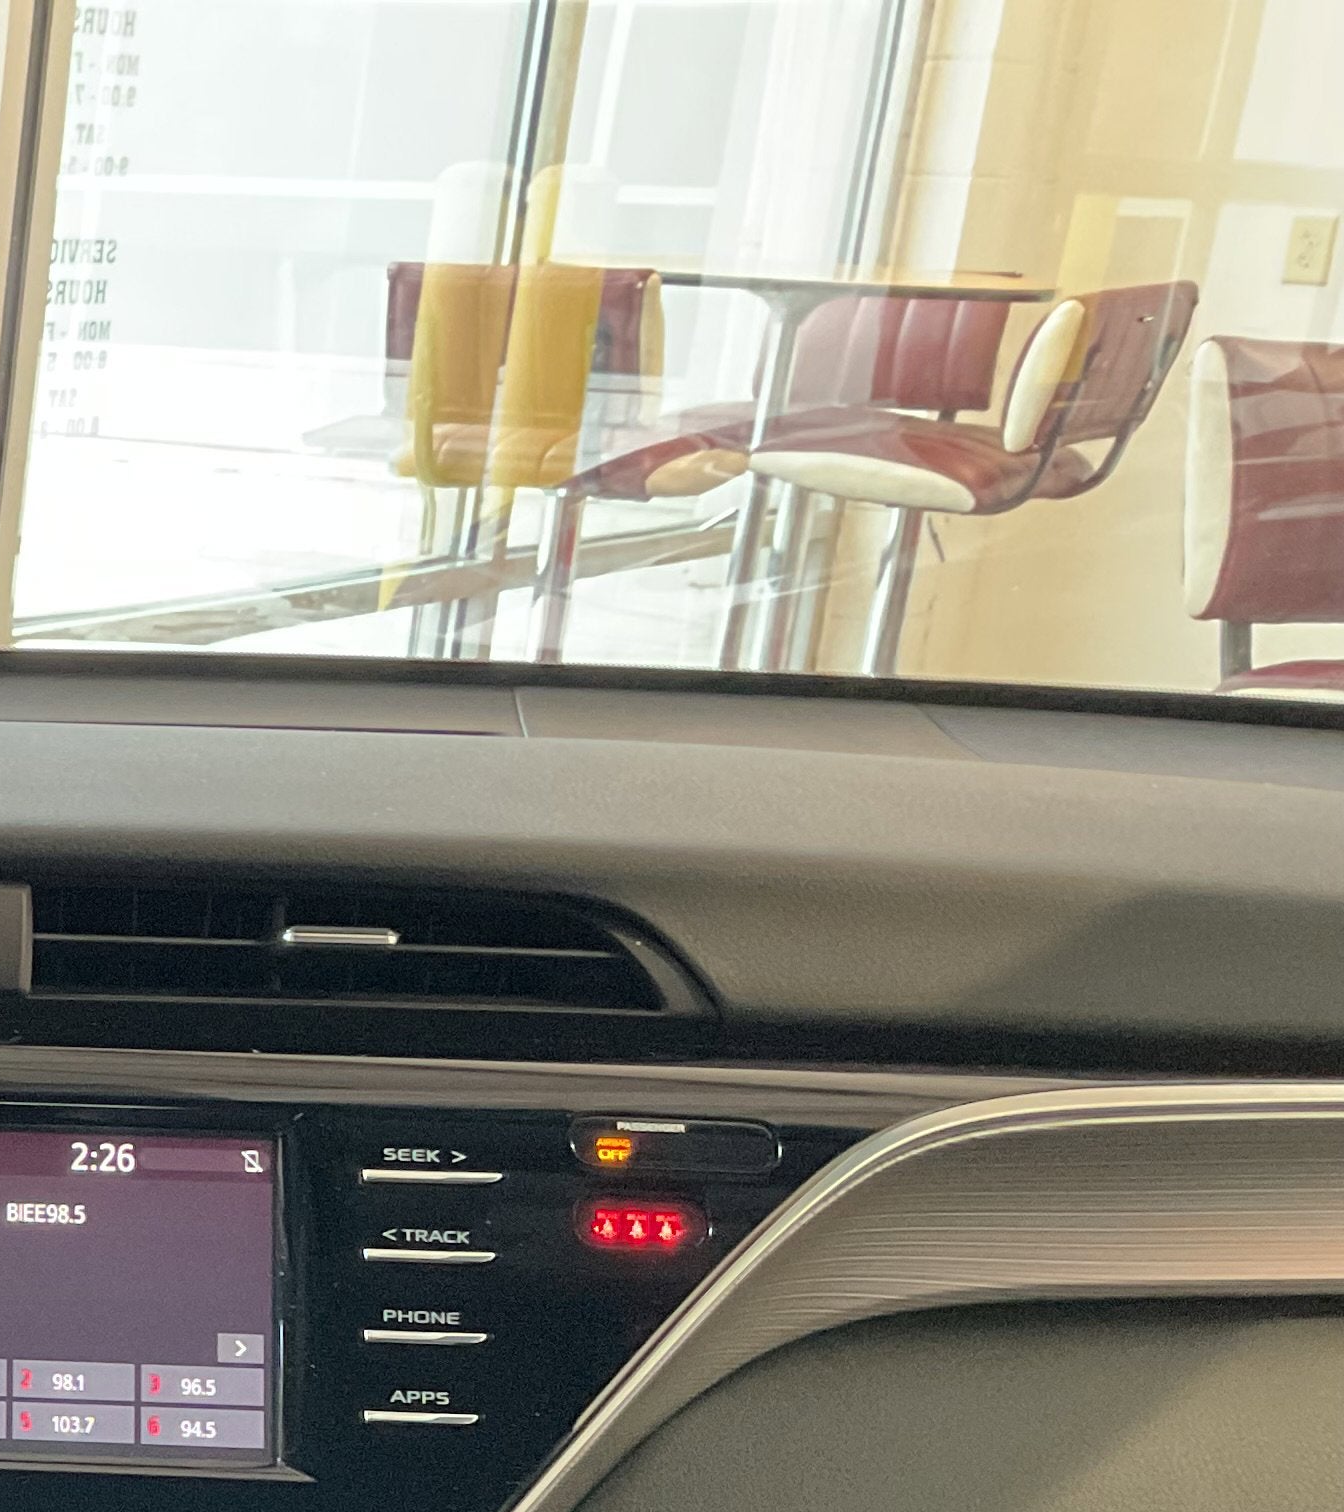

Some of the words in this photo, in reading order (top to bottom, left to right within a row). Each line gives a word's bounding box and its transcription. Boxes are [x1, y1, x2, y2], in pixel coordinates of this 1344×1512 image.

[70, 1142, 137, 1173] 2:26
[383, 1147, 441, 1164] SEEK
[597, 1147, 630, 1162] OFF
[402, 1228, 471, 1245] TRACK
[382, 1308, 461, 1326] PHONE
[52, 1374, 86, 1392] 98.1
[180, 1378, 217, 1397] 96.5
[389, 1389, 451, 1406] APPS
[51, 1415, 96, 1435] 103.7
[180, 1420, 217, 1440] 94.5
